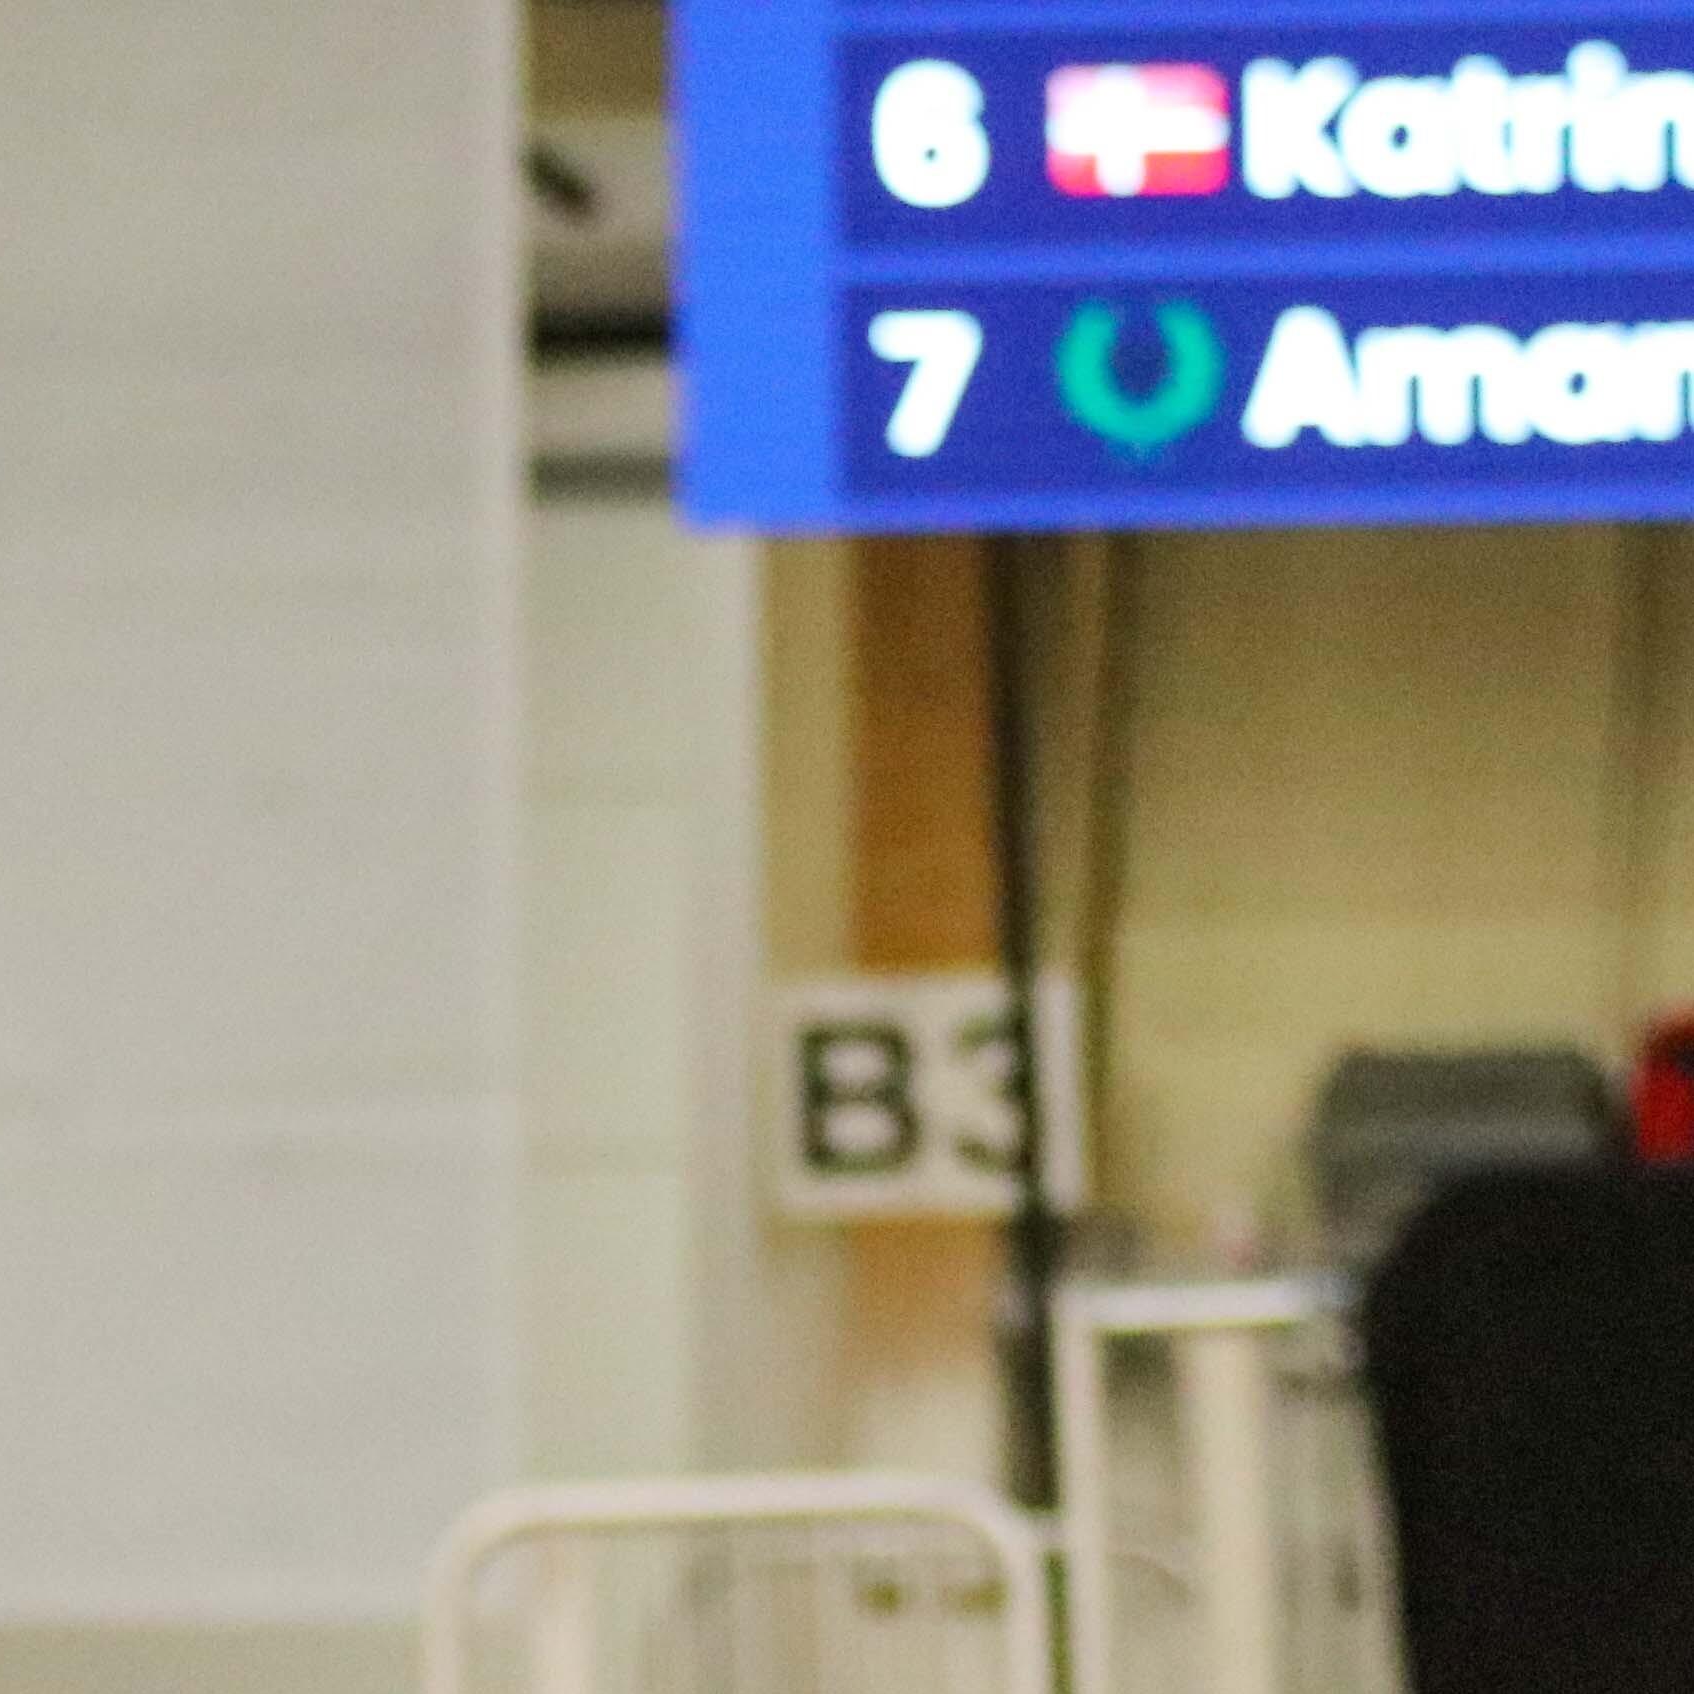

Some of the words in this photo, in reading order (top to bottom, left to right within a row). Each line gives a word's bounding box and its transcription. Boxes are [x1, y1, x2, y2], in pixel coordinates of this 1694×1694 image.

[872, 60, 990, 207] 6
[869, 310, 983, 457] 7
[795, 1017, 1037, 1180] B3
